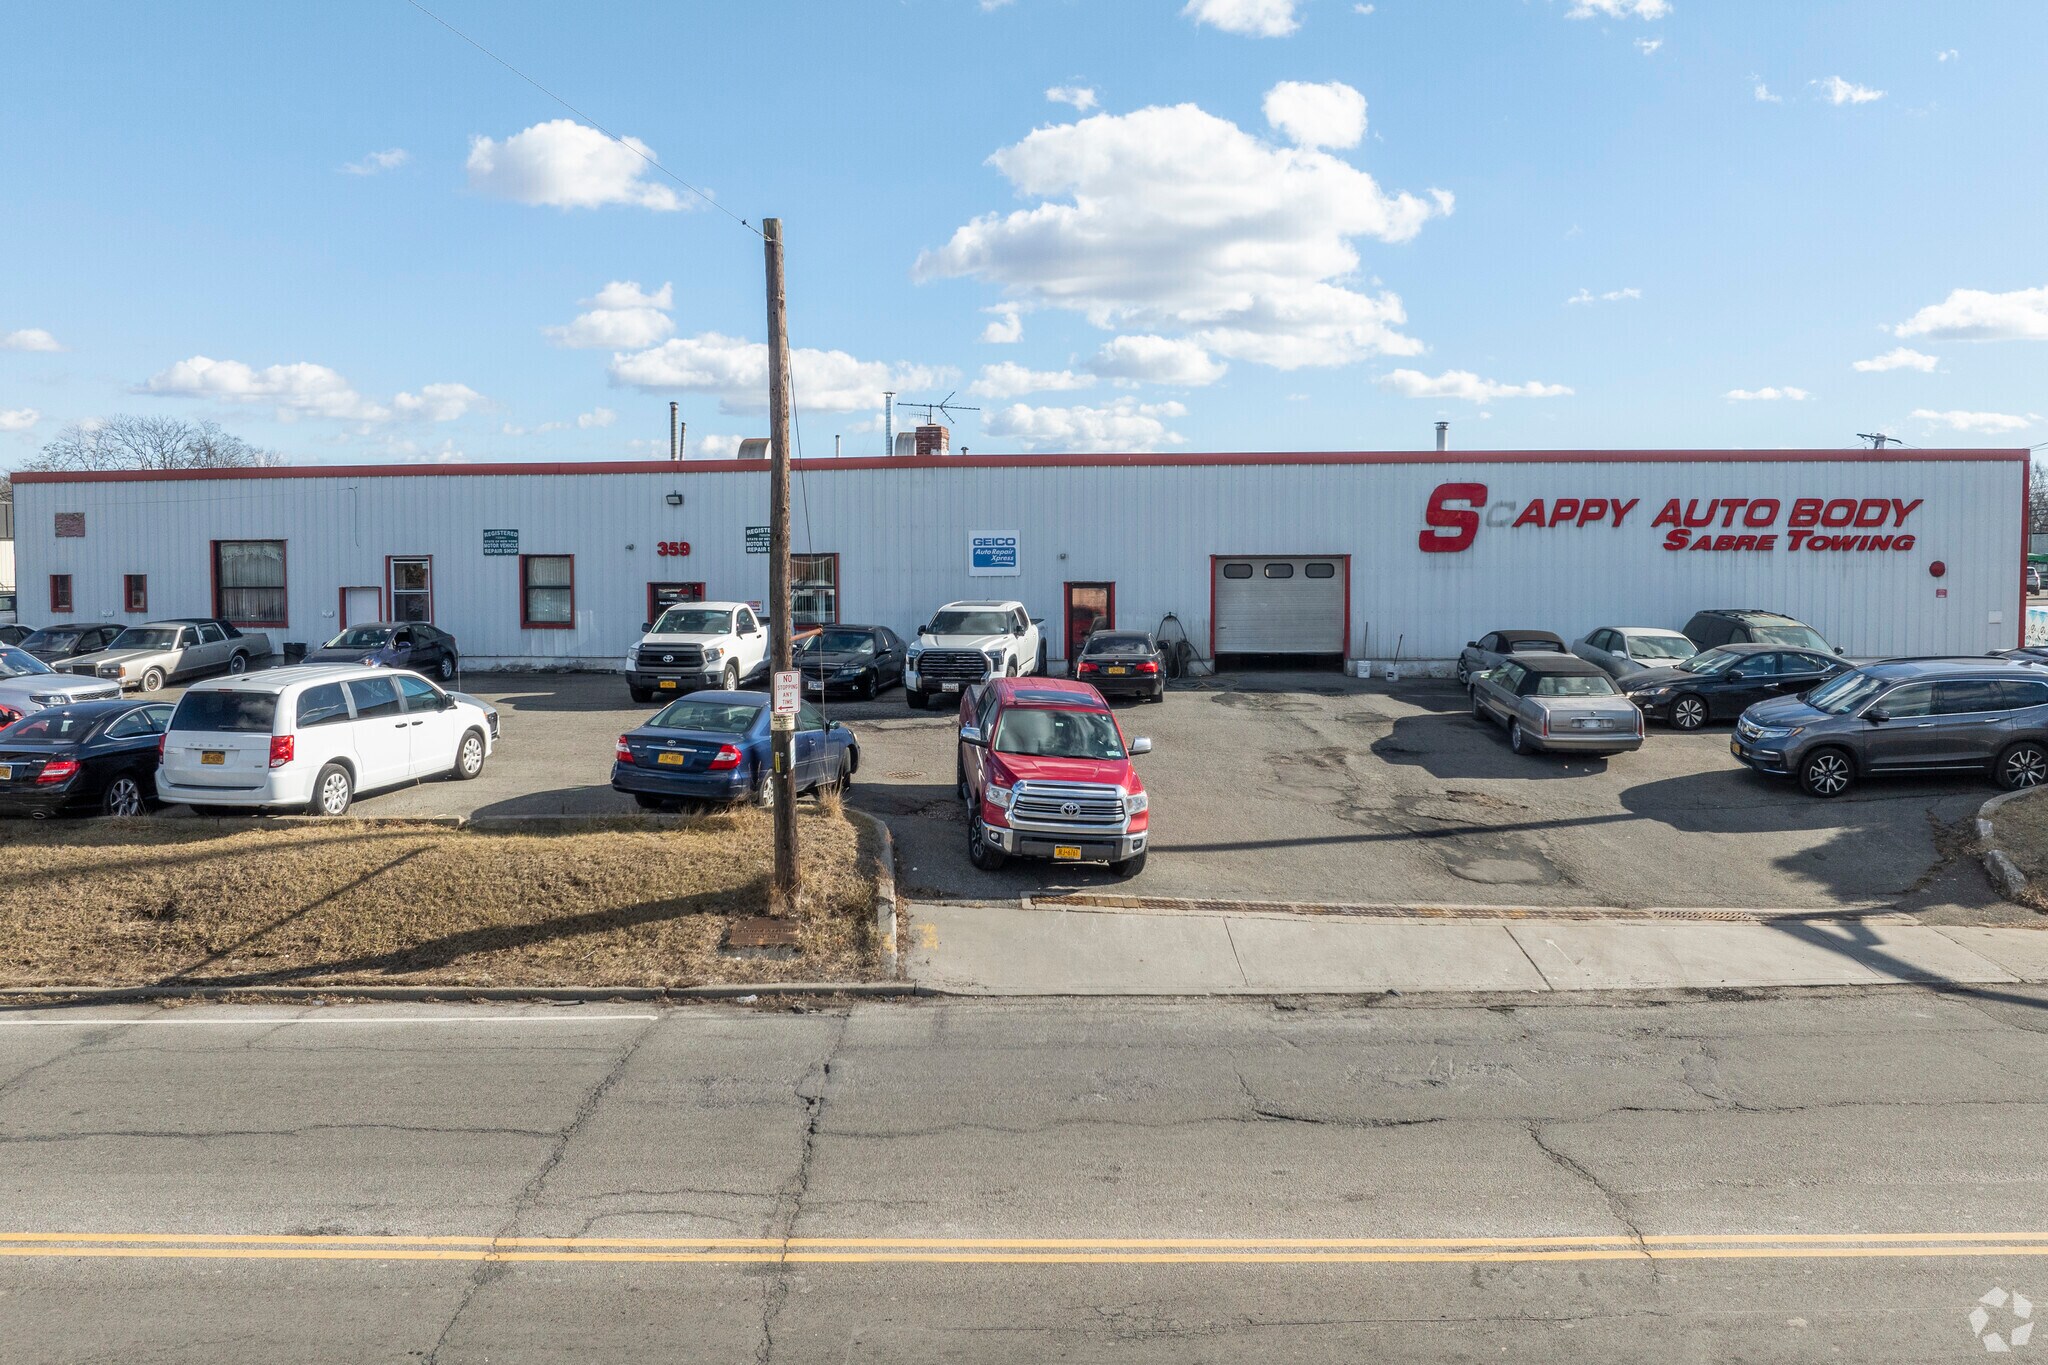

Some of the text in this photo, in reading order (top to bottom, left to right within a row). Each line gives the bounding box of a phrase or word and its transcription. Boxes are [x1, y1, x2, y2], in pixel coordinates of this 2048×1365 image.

[1650, 499, 1780, 527] AUTO
[1788, 499, 1924, 527] BODY
[973, 537, 1016, 546] GEICO
[1663, 529, 1915, 550] SABRE TOWING
[657, 541, 690, 556] 359
[783, 675, 792, 683] NO
